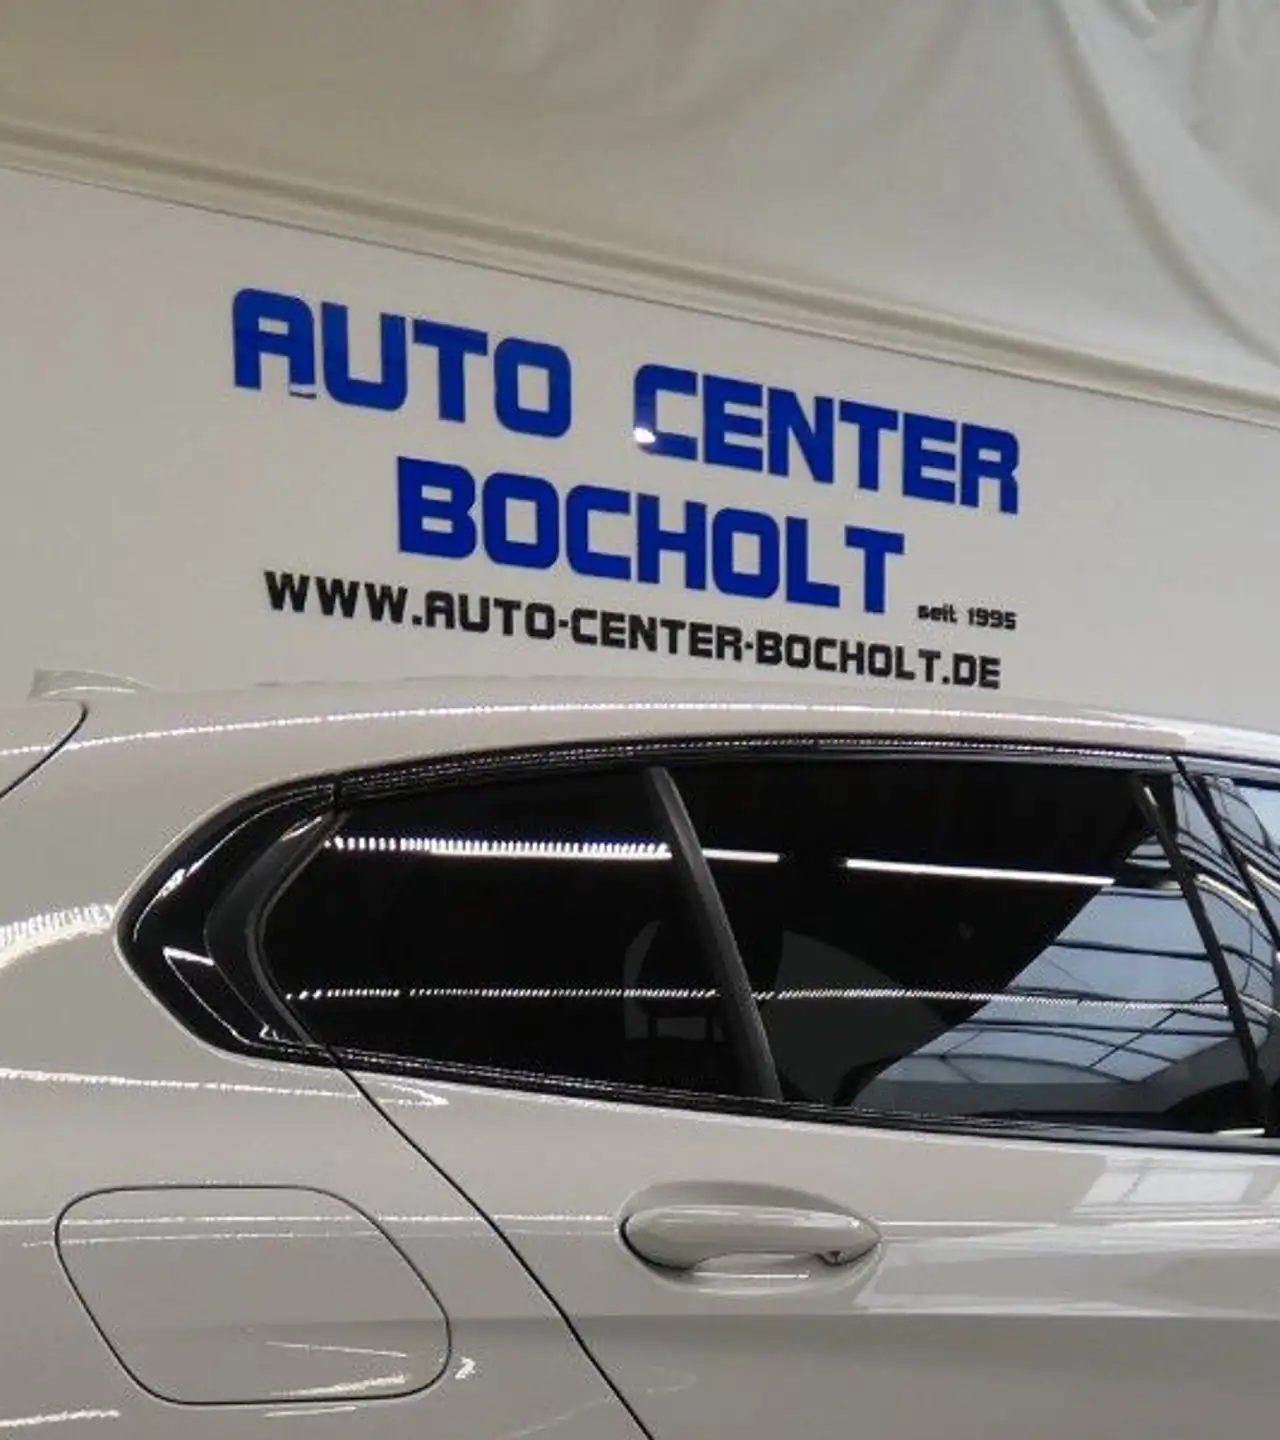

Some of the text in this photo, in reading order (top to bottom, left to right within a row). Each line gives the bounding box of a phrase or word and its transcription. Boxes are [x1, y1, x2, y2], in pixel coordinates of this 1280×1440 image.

[232, 288, 1020, 515] AUTO CENTER
[397, 456, 905, 615] BOCHOLT
[264, 570, 1001, 690] WWW.AUTO-CENTER-BOCHOLT.DE
[917, 604, 1017, 631] seit 1995
